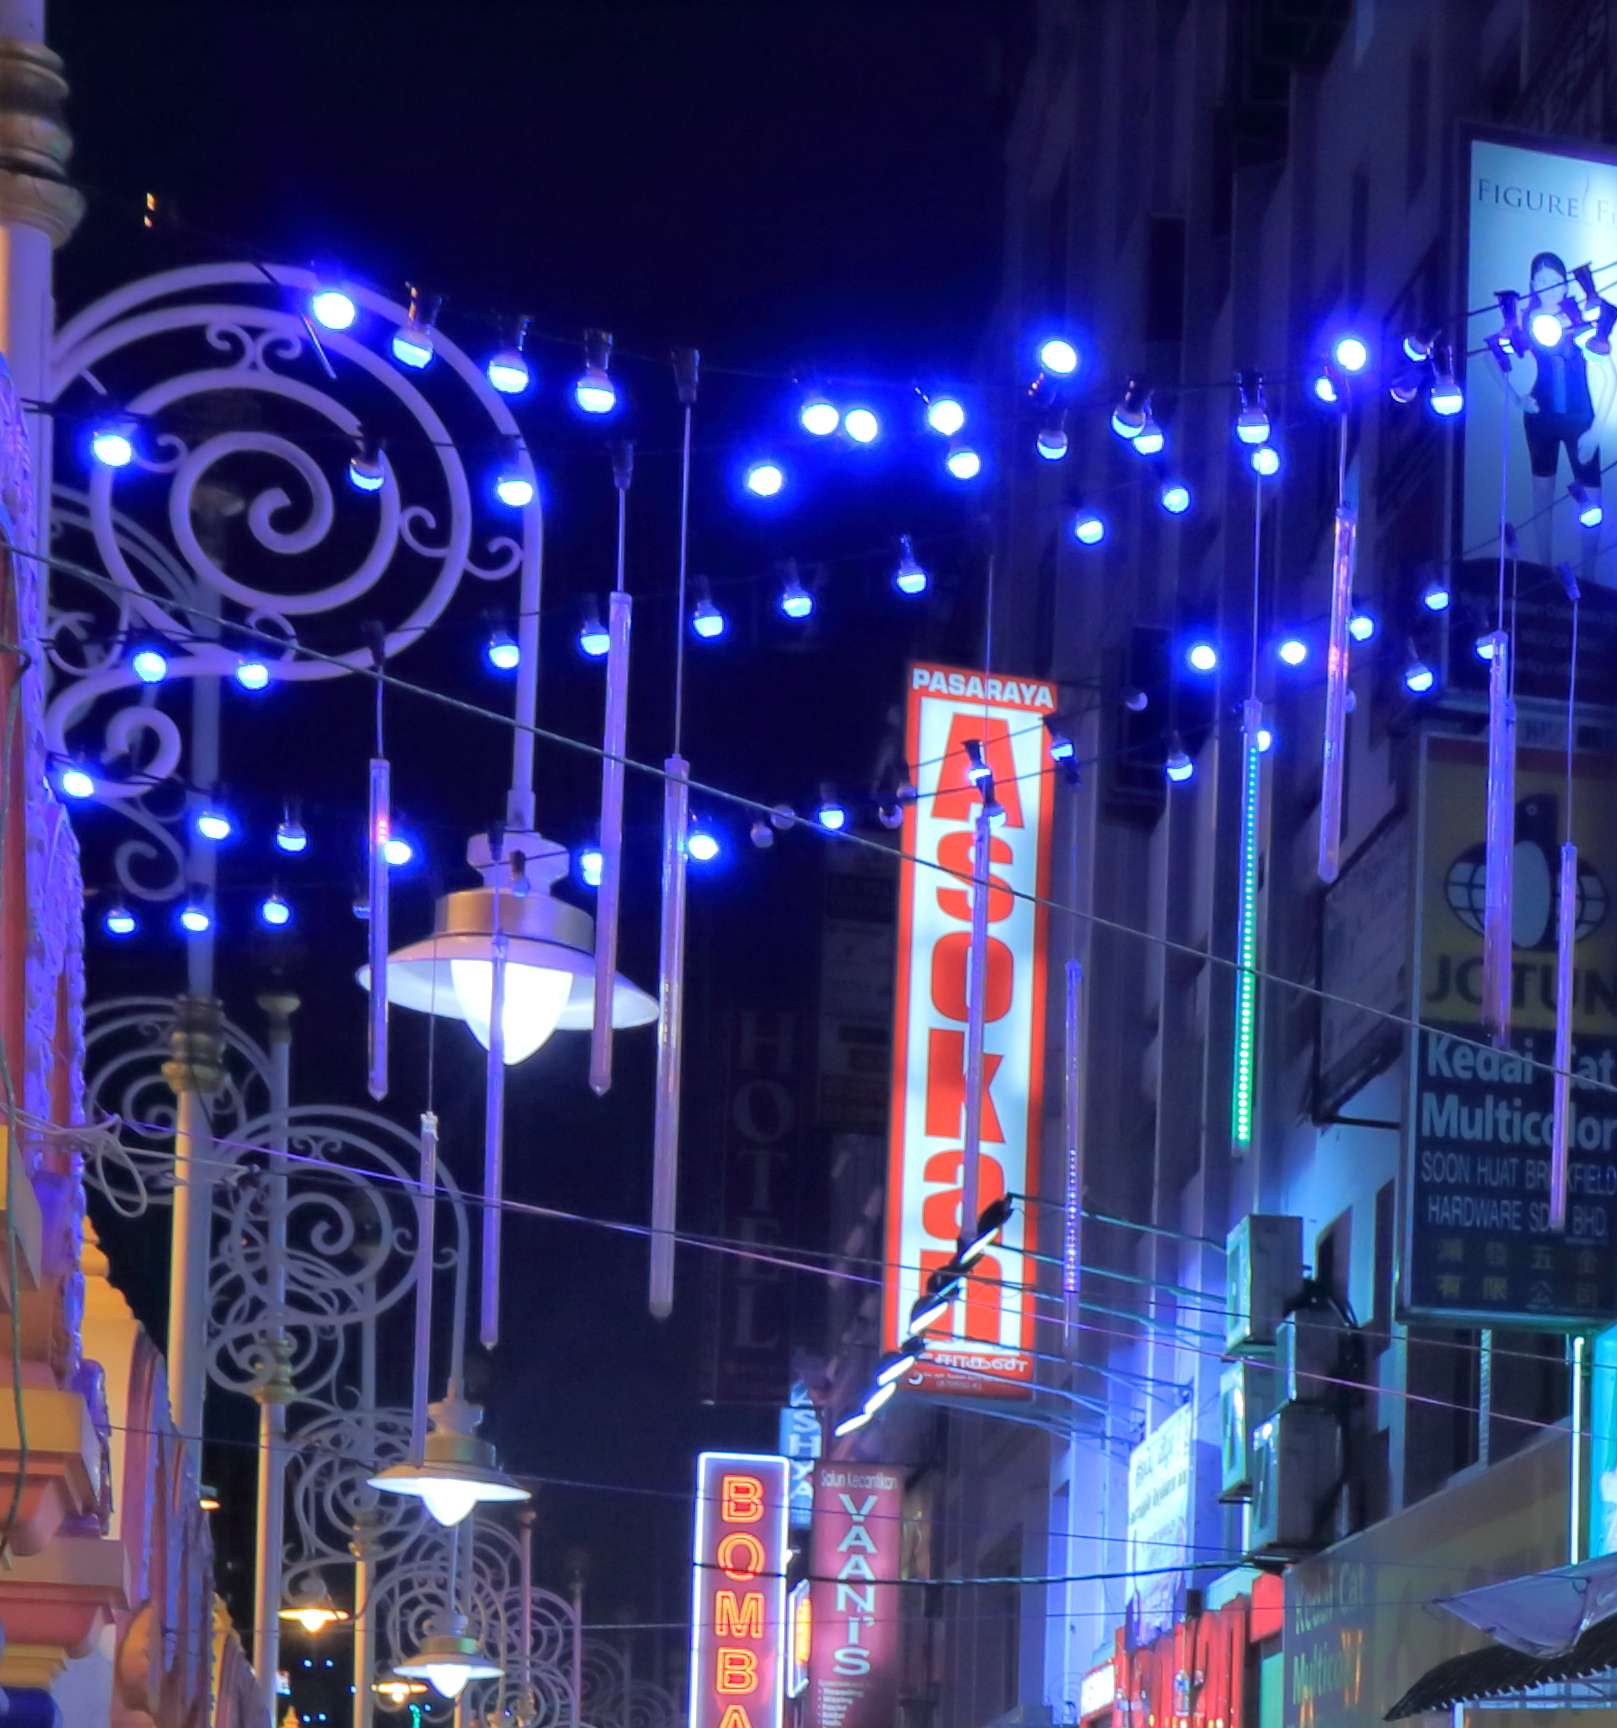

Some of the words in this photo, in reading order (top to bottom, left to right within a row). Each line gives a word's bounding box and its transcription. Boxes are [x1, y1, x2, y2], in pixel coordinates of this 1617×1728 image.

[1478, 178, 1580, 219] FIGURE
[911, 667, 1055, 710] PASARAYA
[1422, 1150, 1470, 1185] SOON
[1476, 1156, 1519, 1188] HUAT
[1428, 1193, 1522, 1232] HARDWARE
